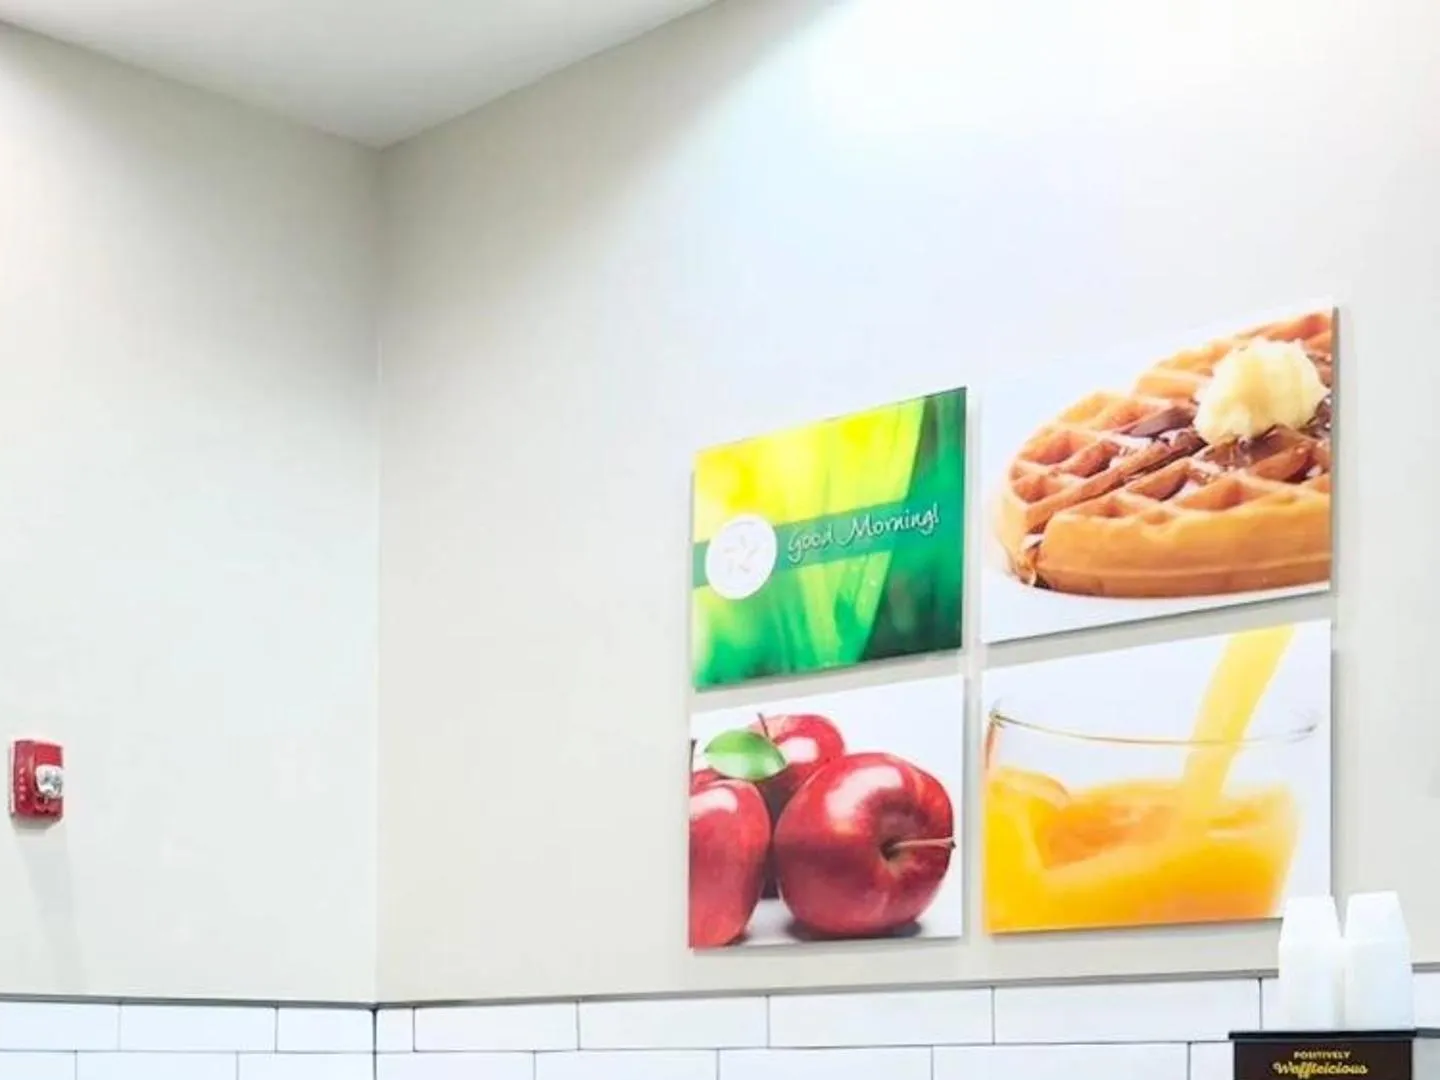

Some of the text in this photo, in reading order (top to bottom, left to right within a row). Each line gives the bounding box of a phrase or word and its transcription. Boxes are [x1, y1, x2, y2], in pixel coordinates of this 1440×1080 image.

[787, 501, 939, 563] Good Morning!
[1293, 1051, 1351, 1060] POSITIVELY
